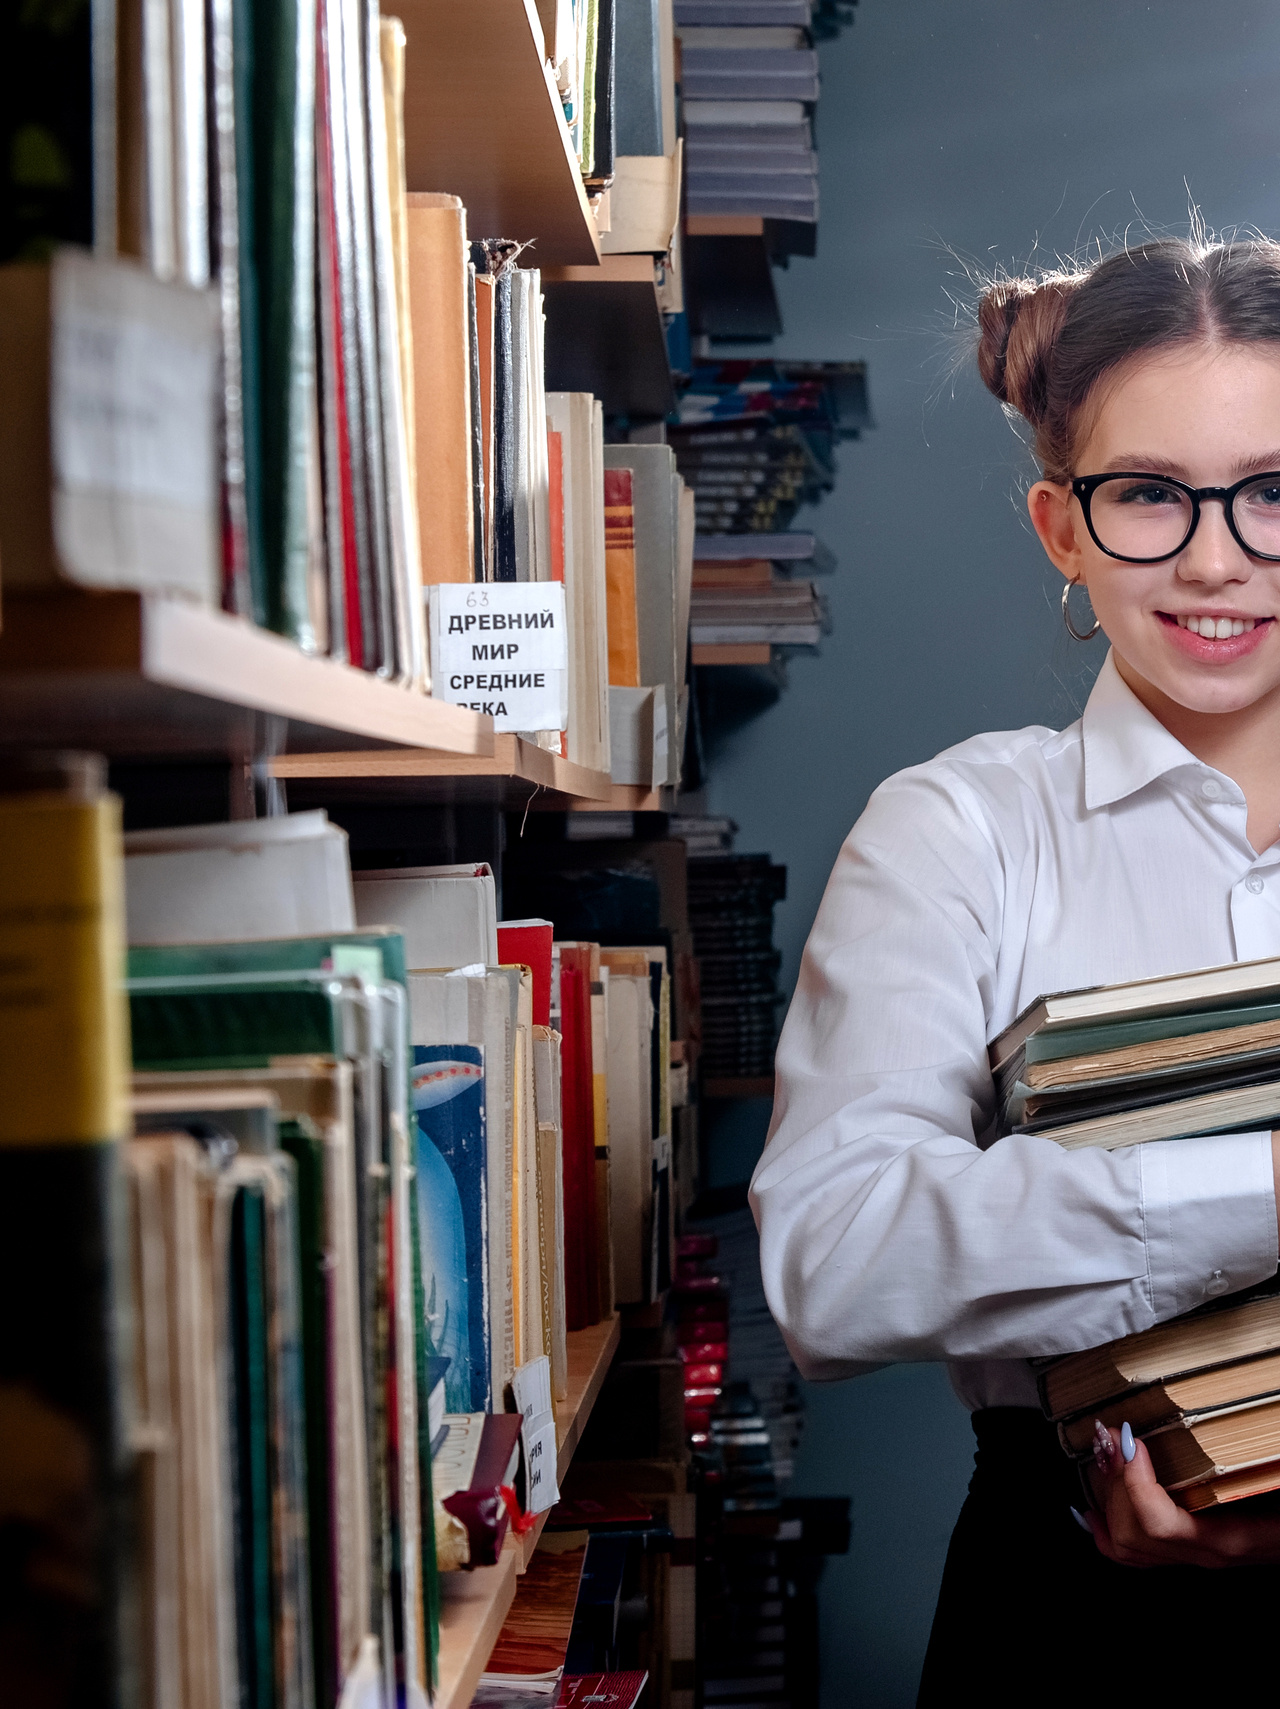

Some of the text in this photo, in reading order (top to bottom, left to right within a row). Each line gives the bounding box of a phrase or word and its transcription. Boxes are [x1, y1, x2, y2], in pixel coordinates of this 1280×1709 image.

[466, 591, 489, 607] 63
[448, 609, 554, 634] ДРЕВНИЙ
[472, 644, 519, 660] МИР
[450, 674, 545, 691] СРЕДНИЕ
[456, 702, 508, 716] ЕКА
